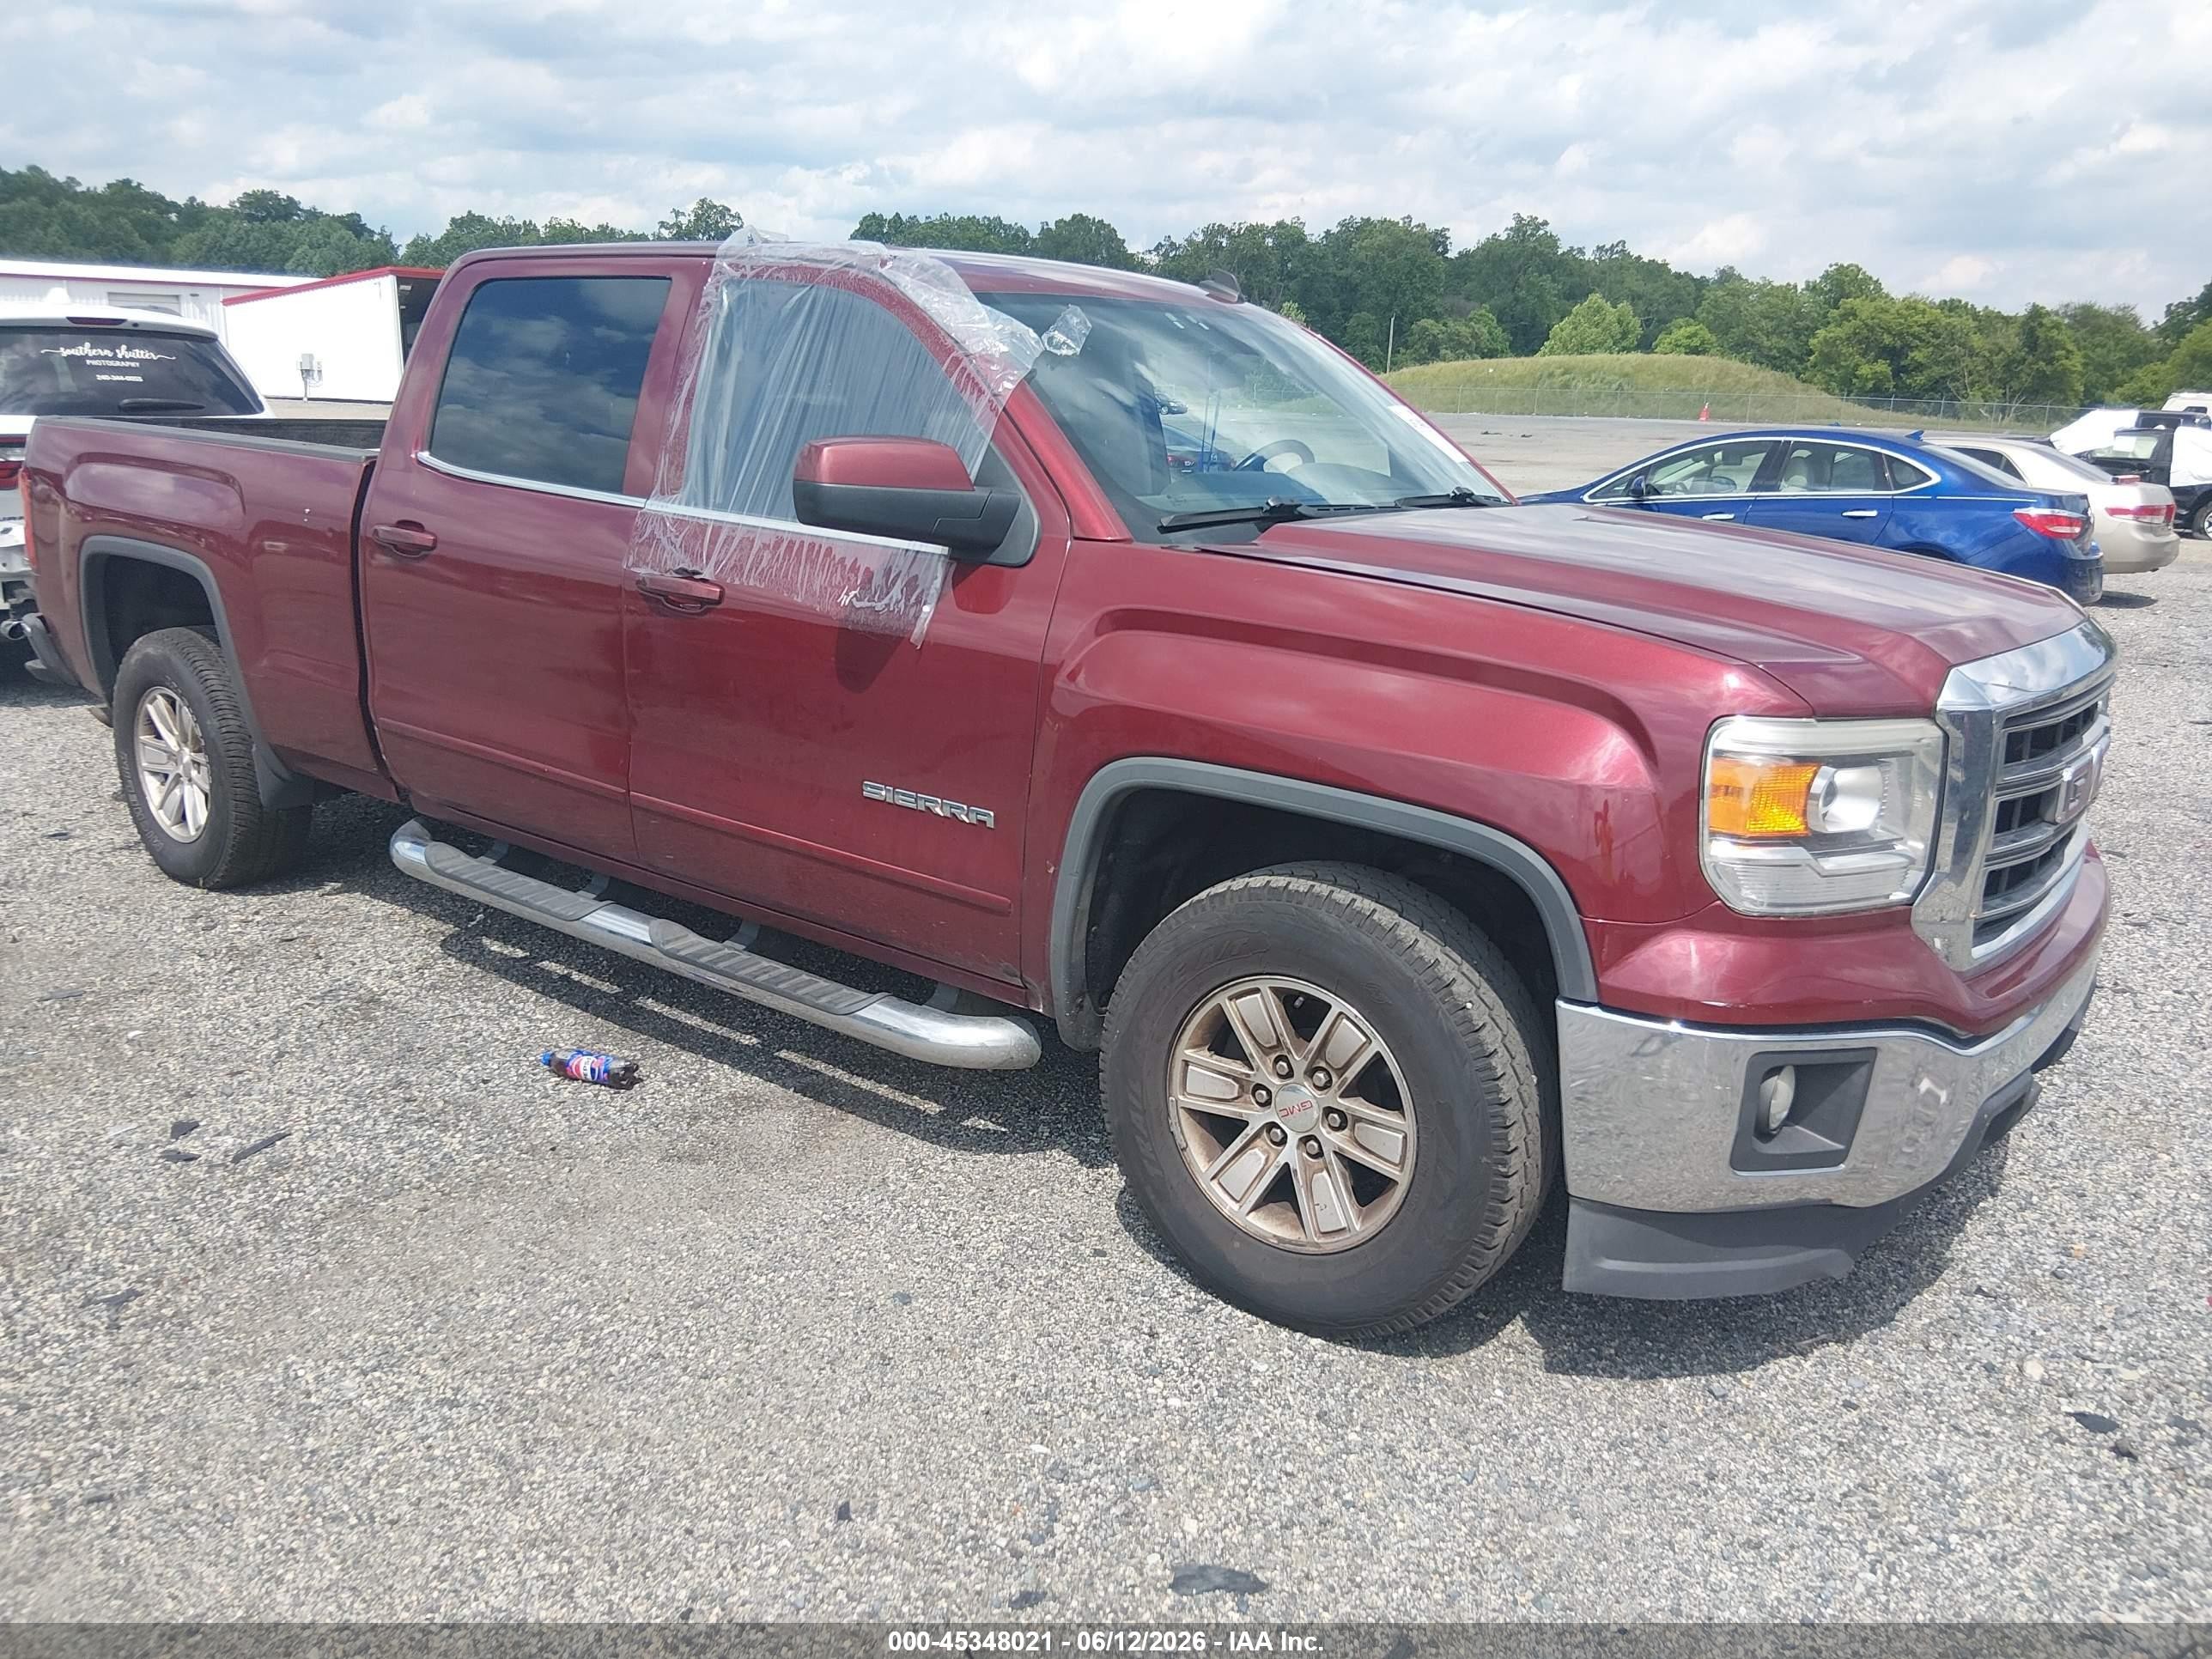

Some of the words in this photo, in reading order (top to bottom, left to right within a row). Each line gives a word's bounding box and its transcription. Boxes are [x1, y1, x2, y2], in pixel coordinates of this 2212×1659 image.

[41, 342, 114, 357] southern
[116, 344, 176, 360] shutter
[87, 359, 140, 368] PHOTOGRAPHY
[862, 780, 995, 830] SIERRA
[1279, 1099, 1314, 1118] GMC
